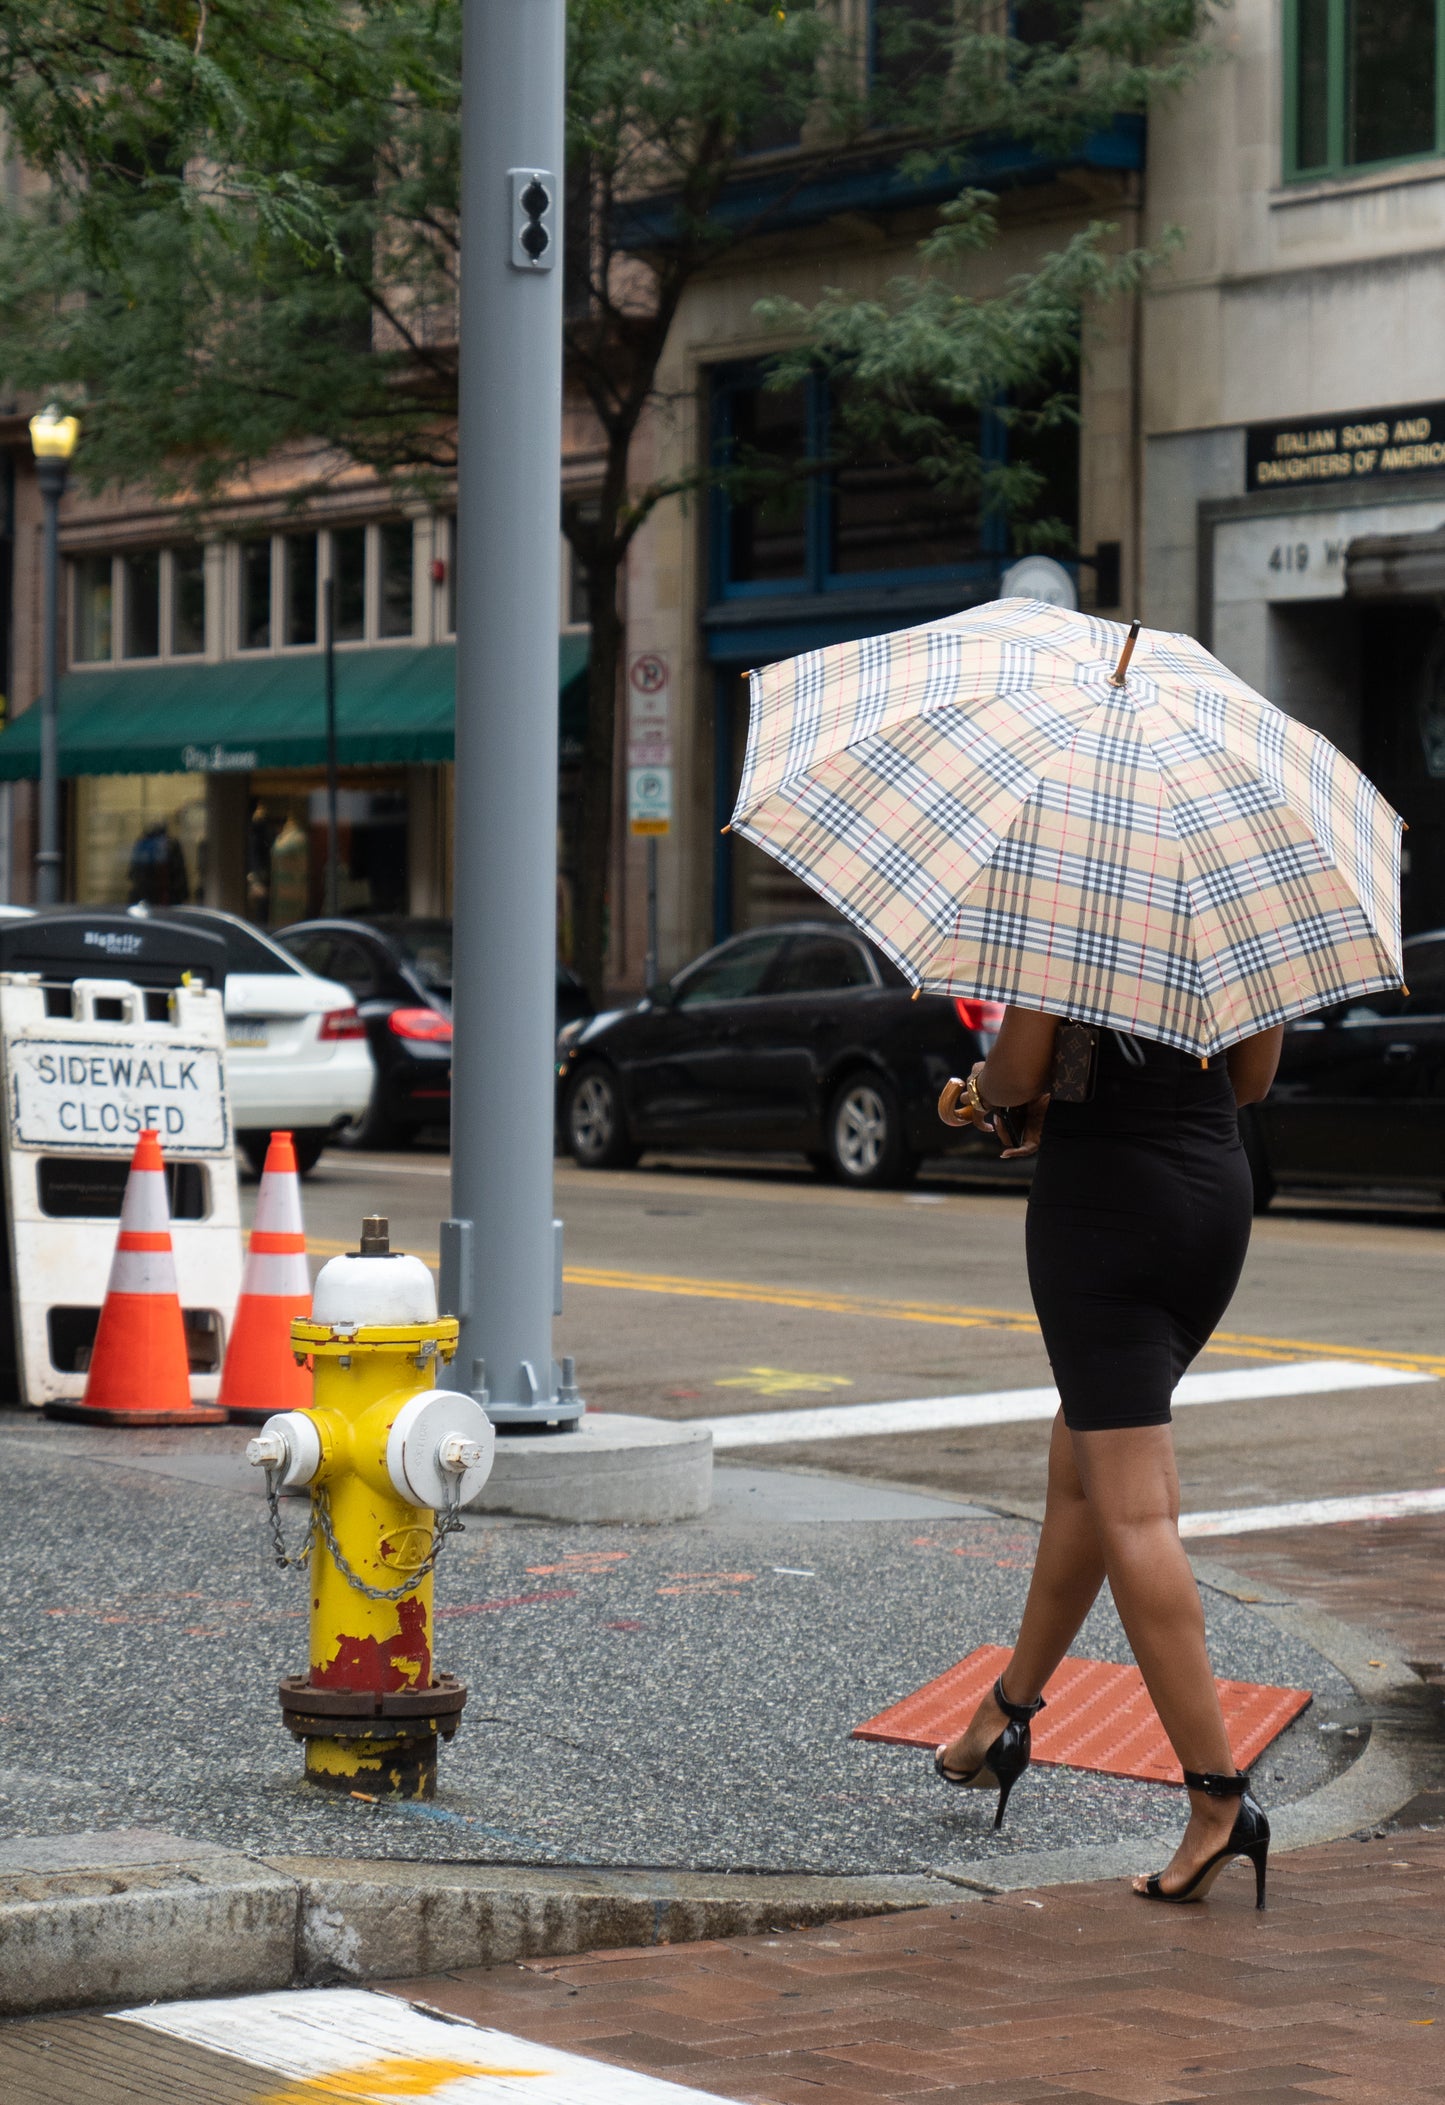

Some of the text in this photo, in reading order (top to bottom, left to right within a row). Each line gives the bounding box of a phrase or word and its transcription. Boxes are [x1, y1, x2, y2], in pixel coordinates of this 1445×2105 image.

[1277, 418, 1431, 453] ITALIAN SONS AND
[1258, 455, 1352, 483] DAUGHTERS
[1355, 450, 1378, 474] OF
[1269, 544, 1309, 572] 419
[38, 1055, 199, 1091] SIDEWALK
[59, 1101, 185, 1135] CLOSED
